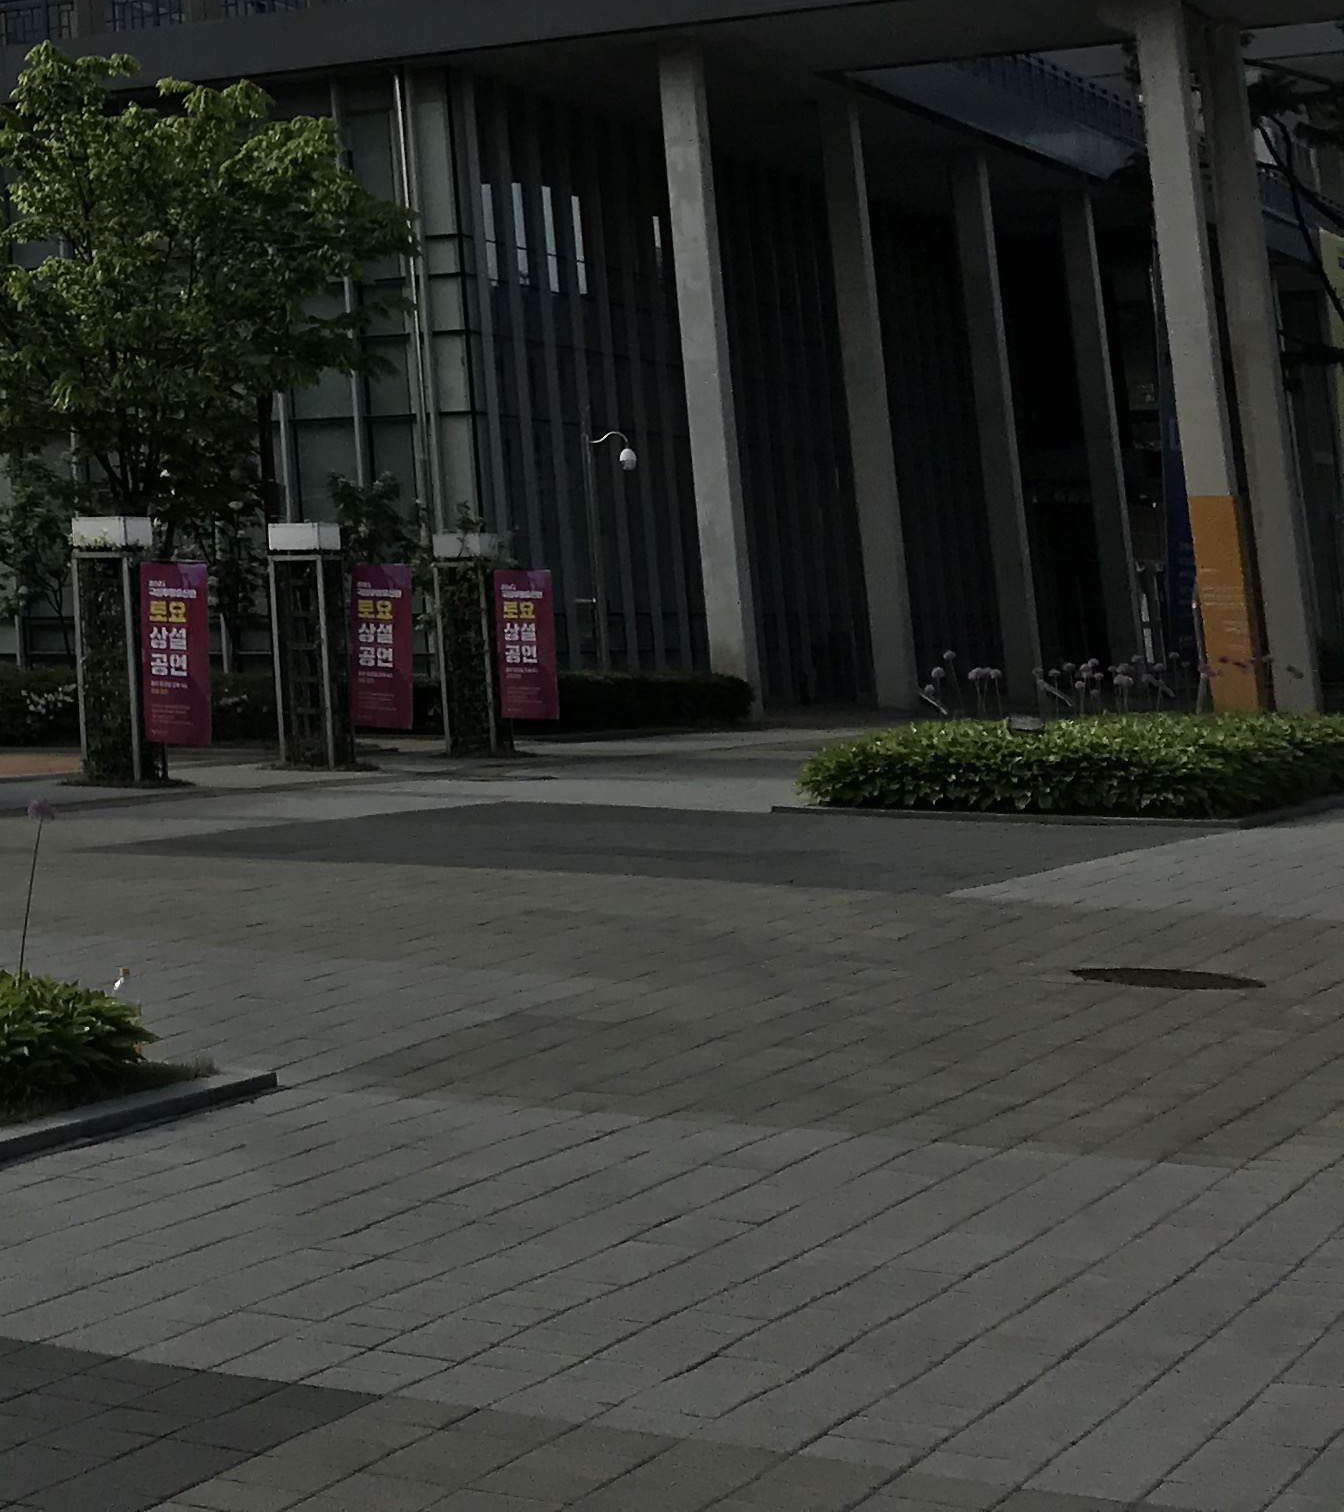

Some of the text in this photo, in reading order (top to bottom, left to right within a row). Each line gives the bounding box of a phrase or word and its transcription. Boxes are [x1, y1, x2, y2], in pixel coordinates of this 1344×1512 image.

[149, 601, 186, 622] 토요
[357, 600, 392, 620] 토요
[503, 601, 535, 619] 토요
[149, 627, 186, 650] 상설
[358, 623, 392, 644] 상설
[504, 623, 536, 641] 상설
[359, 647, 393, 667] 공연
[505, 645, 537, 663] 공연
[150, 654, 186, 676] 공연
